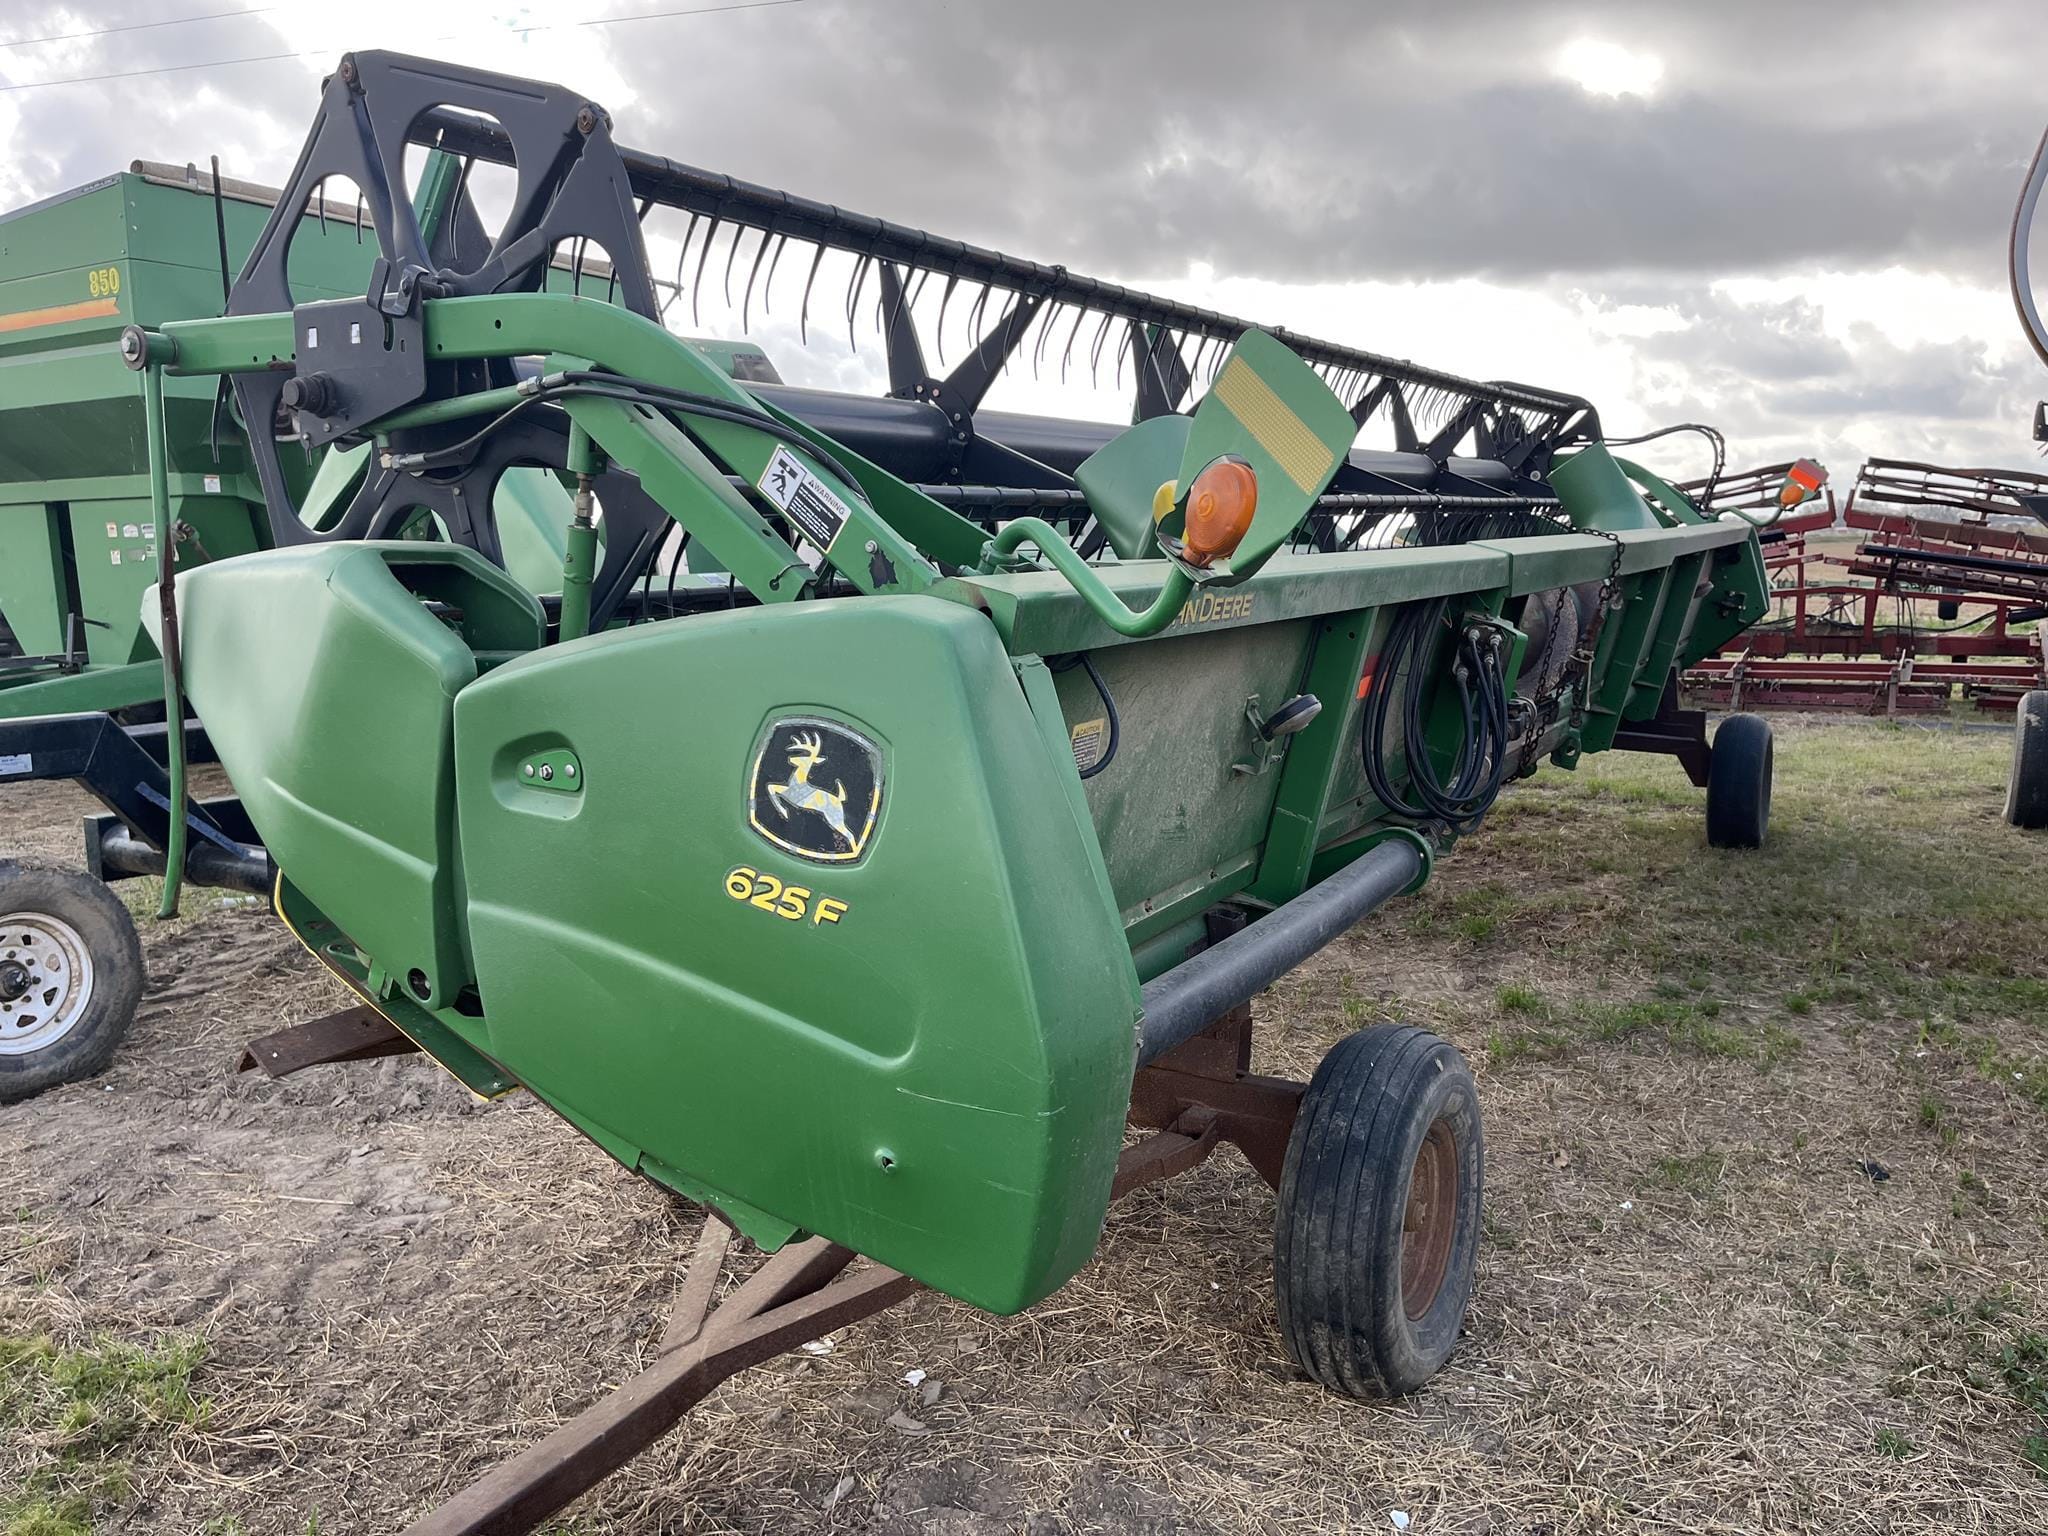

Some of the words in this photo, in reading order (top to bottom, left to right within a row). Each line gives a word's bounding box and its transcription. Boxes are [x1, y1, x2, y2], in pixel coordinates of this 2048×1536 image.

[89, 267, 120, 297] 850
[813, 483, 846, 515] WARNING
[1199, 592, 1254, 622] DEERE
